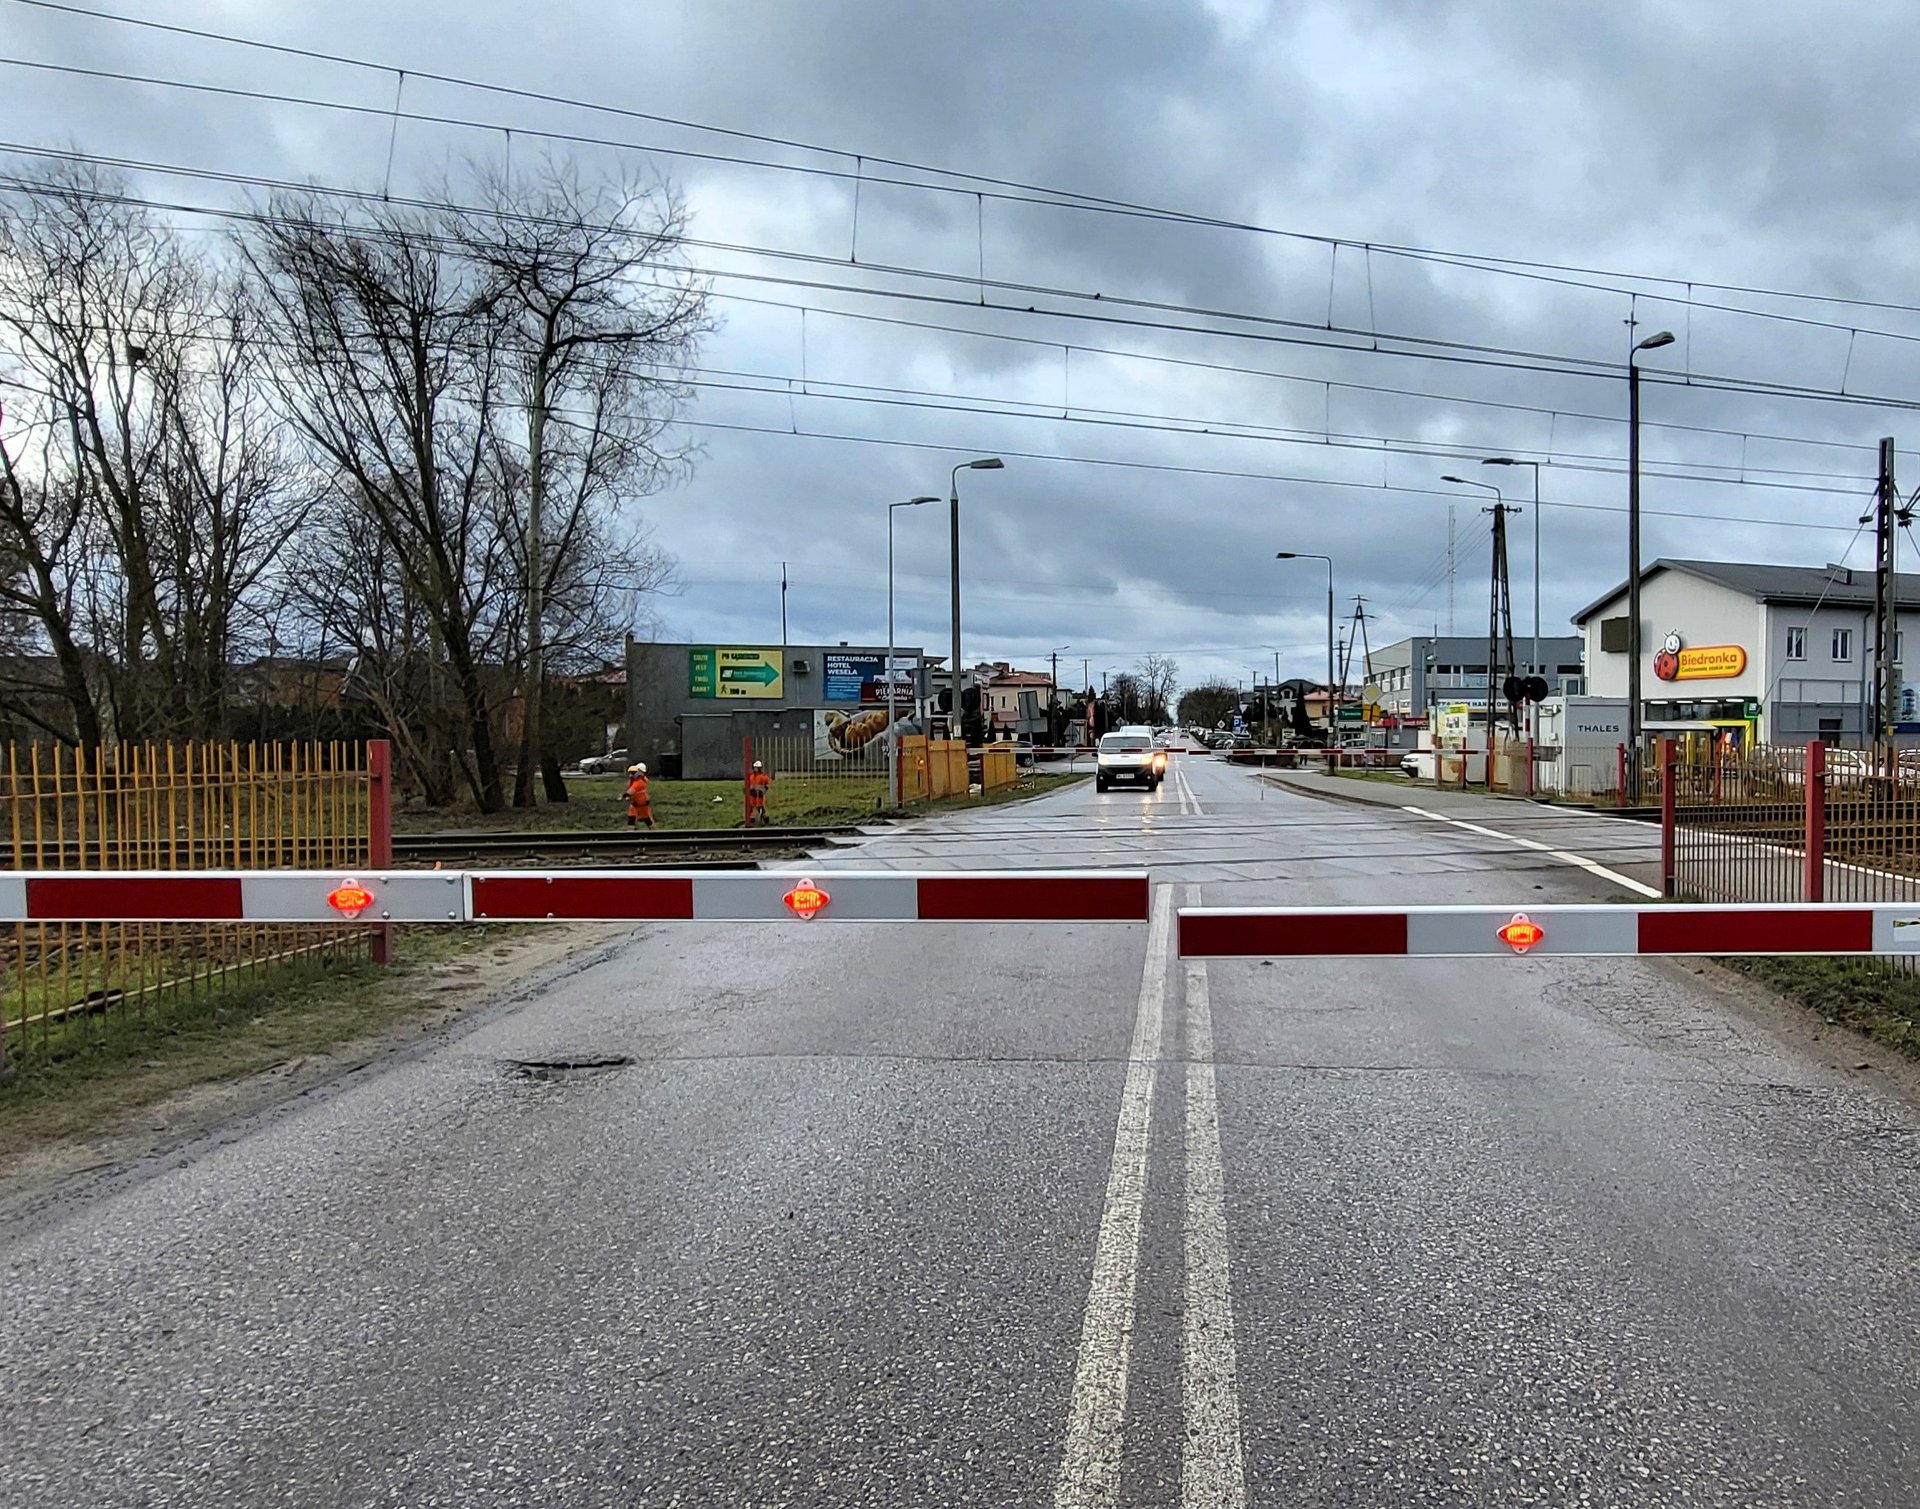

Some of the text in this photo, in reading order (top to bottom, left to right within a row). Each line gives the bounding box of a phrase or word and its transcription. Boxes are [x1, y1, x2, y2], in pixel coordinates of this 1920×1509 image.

[827, 655, 879, 663] RESTAURACJA
[1681, 651, 1737, 666] Biedronka
[1233, 719, 1240, 727] P
[1577, 724, 1620, 733] THALES
